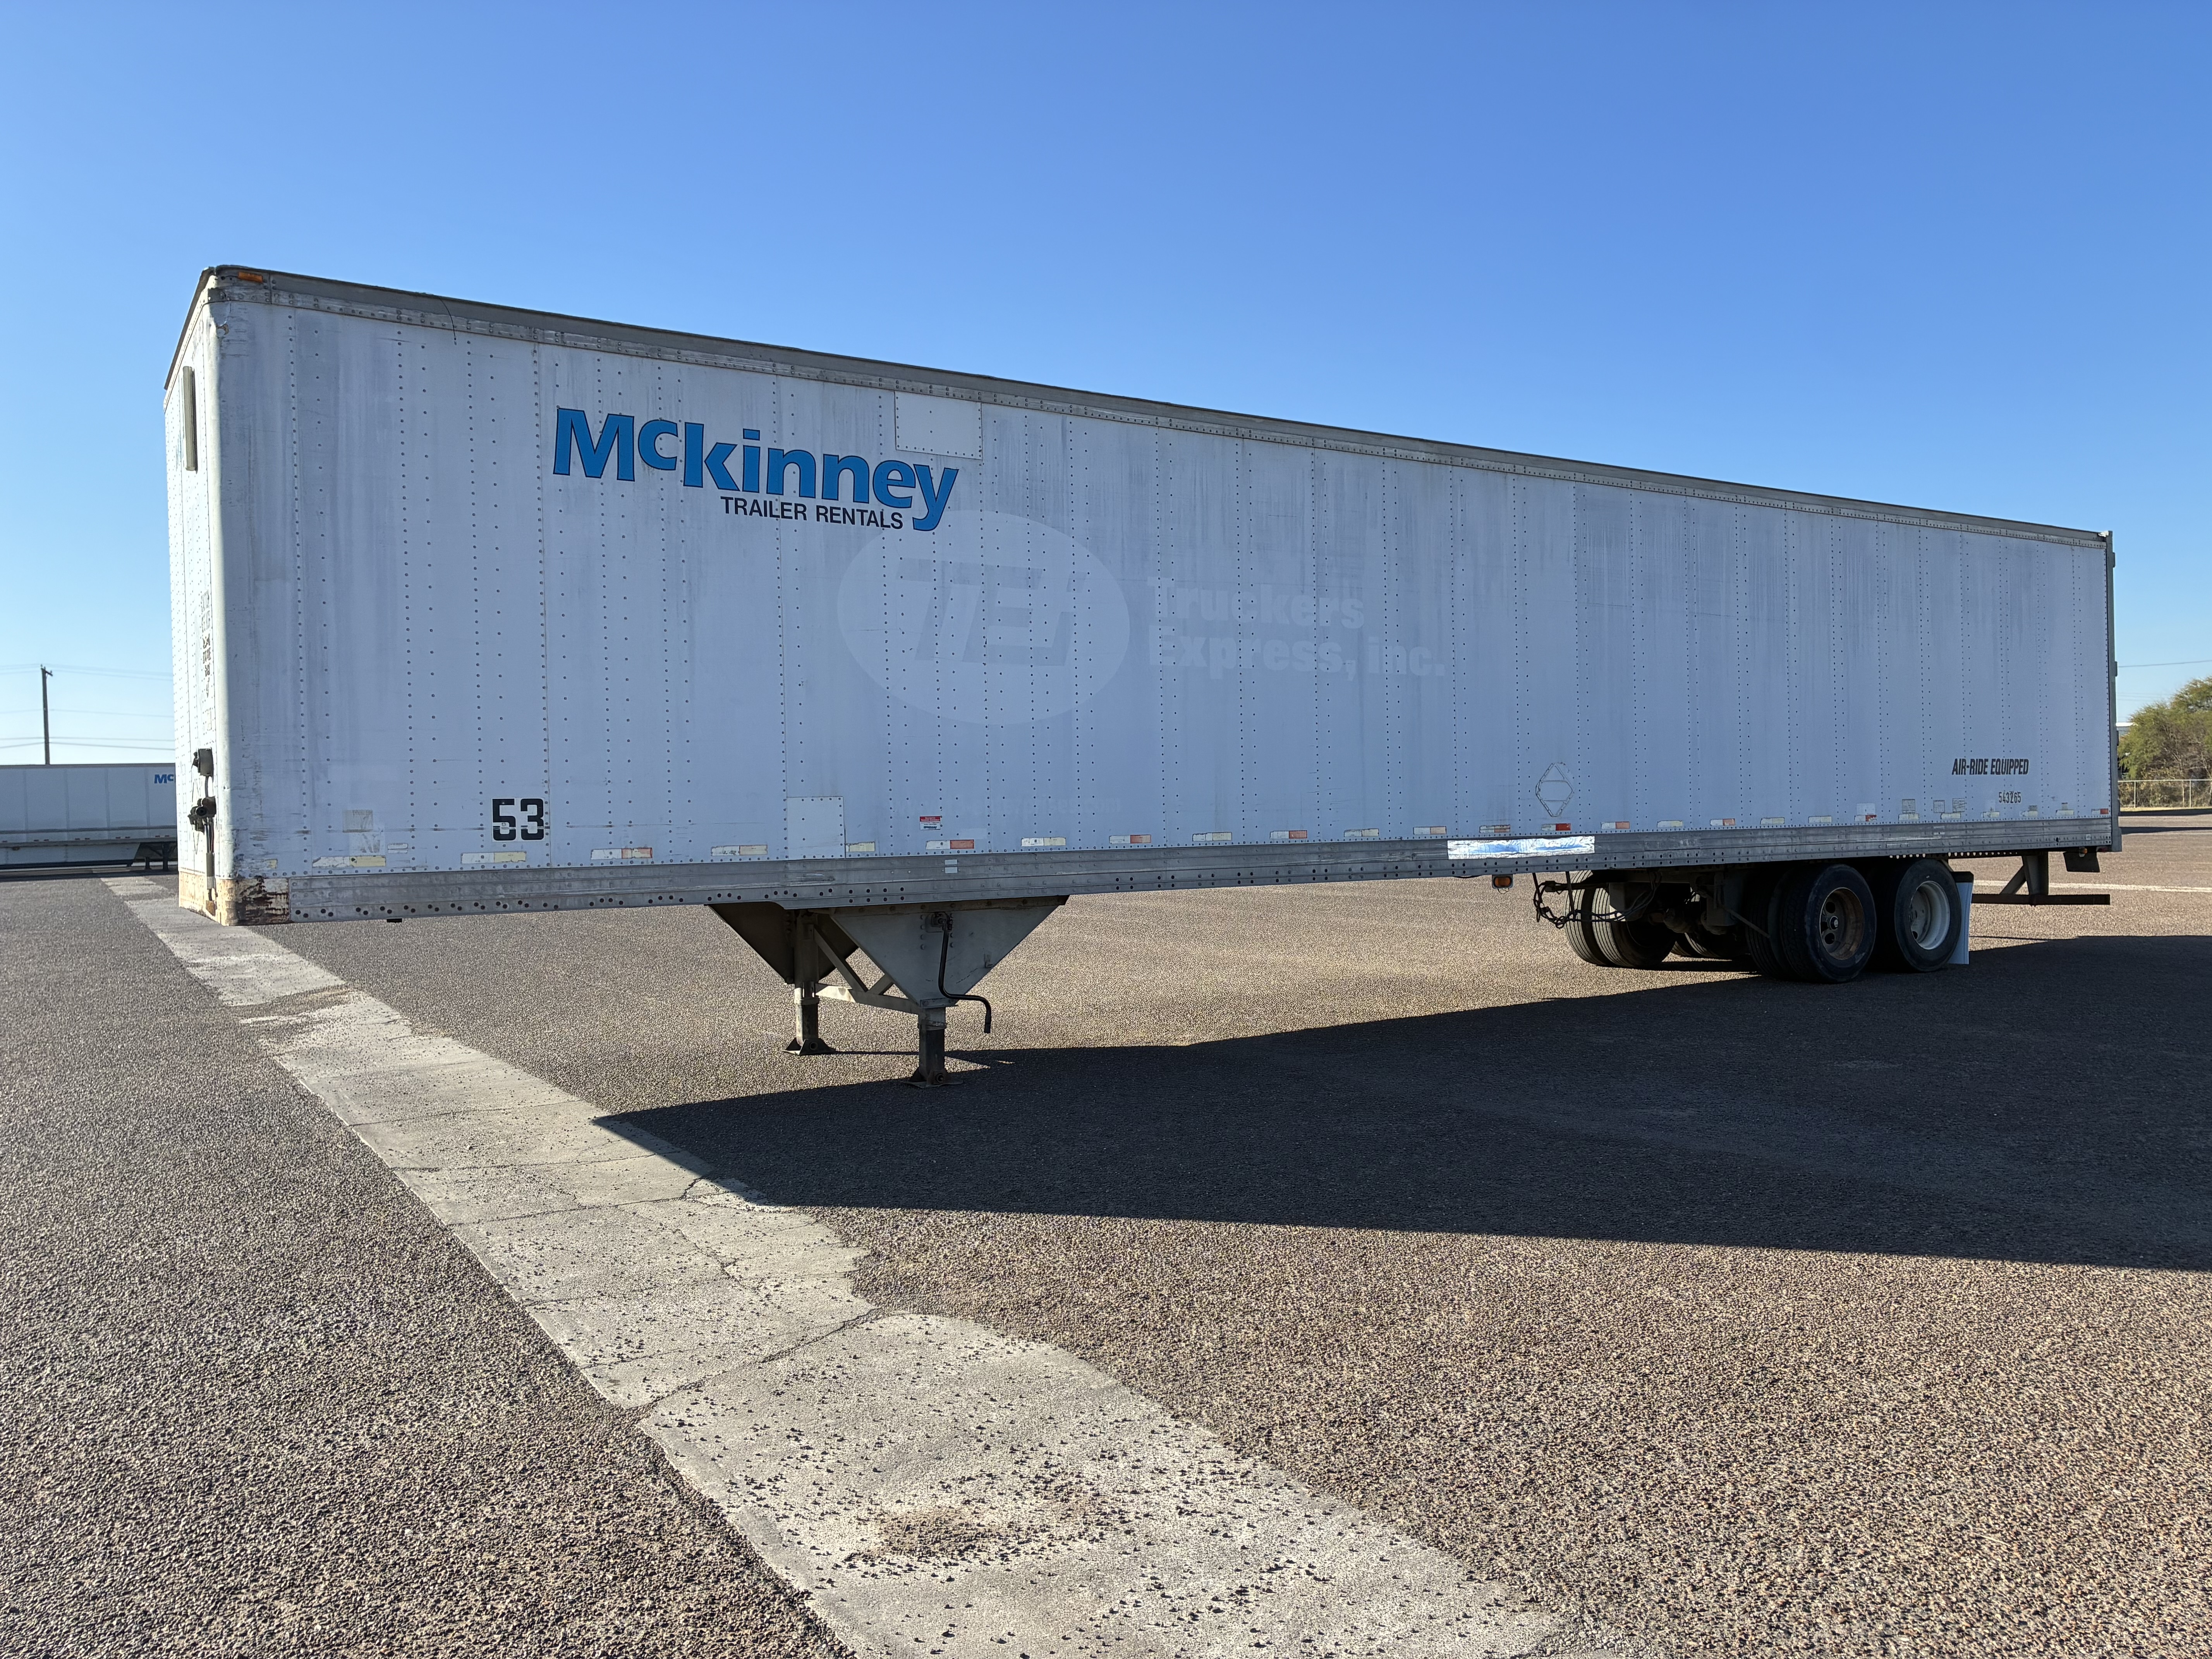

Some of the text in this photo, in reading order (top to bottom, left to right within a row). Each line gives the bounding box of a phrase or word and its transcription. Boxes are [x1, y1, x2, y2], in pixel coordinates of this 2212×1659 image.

[720, 496, 903, 529] TRAILER RENTALS
[1147, 576, 1365, 629] Truckers
[1148, 625, 1445, 681] Express, inc.
[154, 774, 176, 784] Mc
[1952, 758, 2029, 775] AIR-RIDE EQUIPPED
[492, 798, 544, 841] 53
